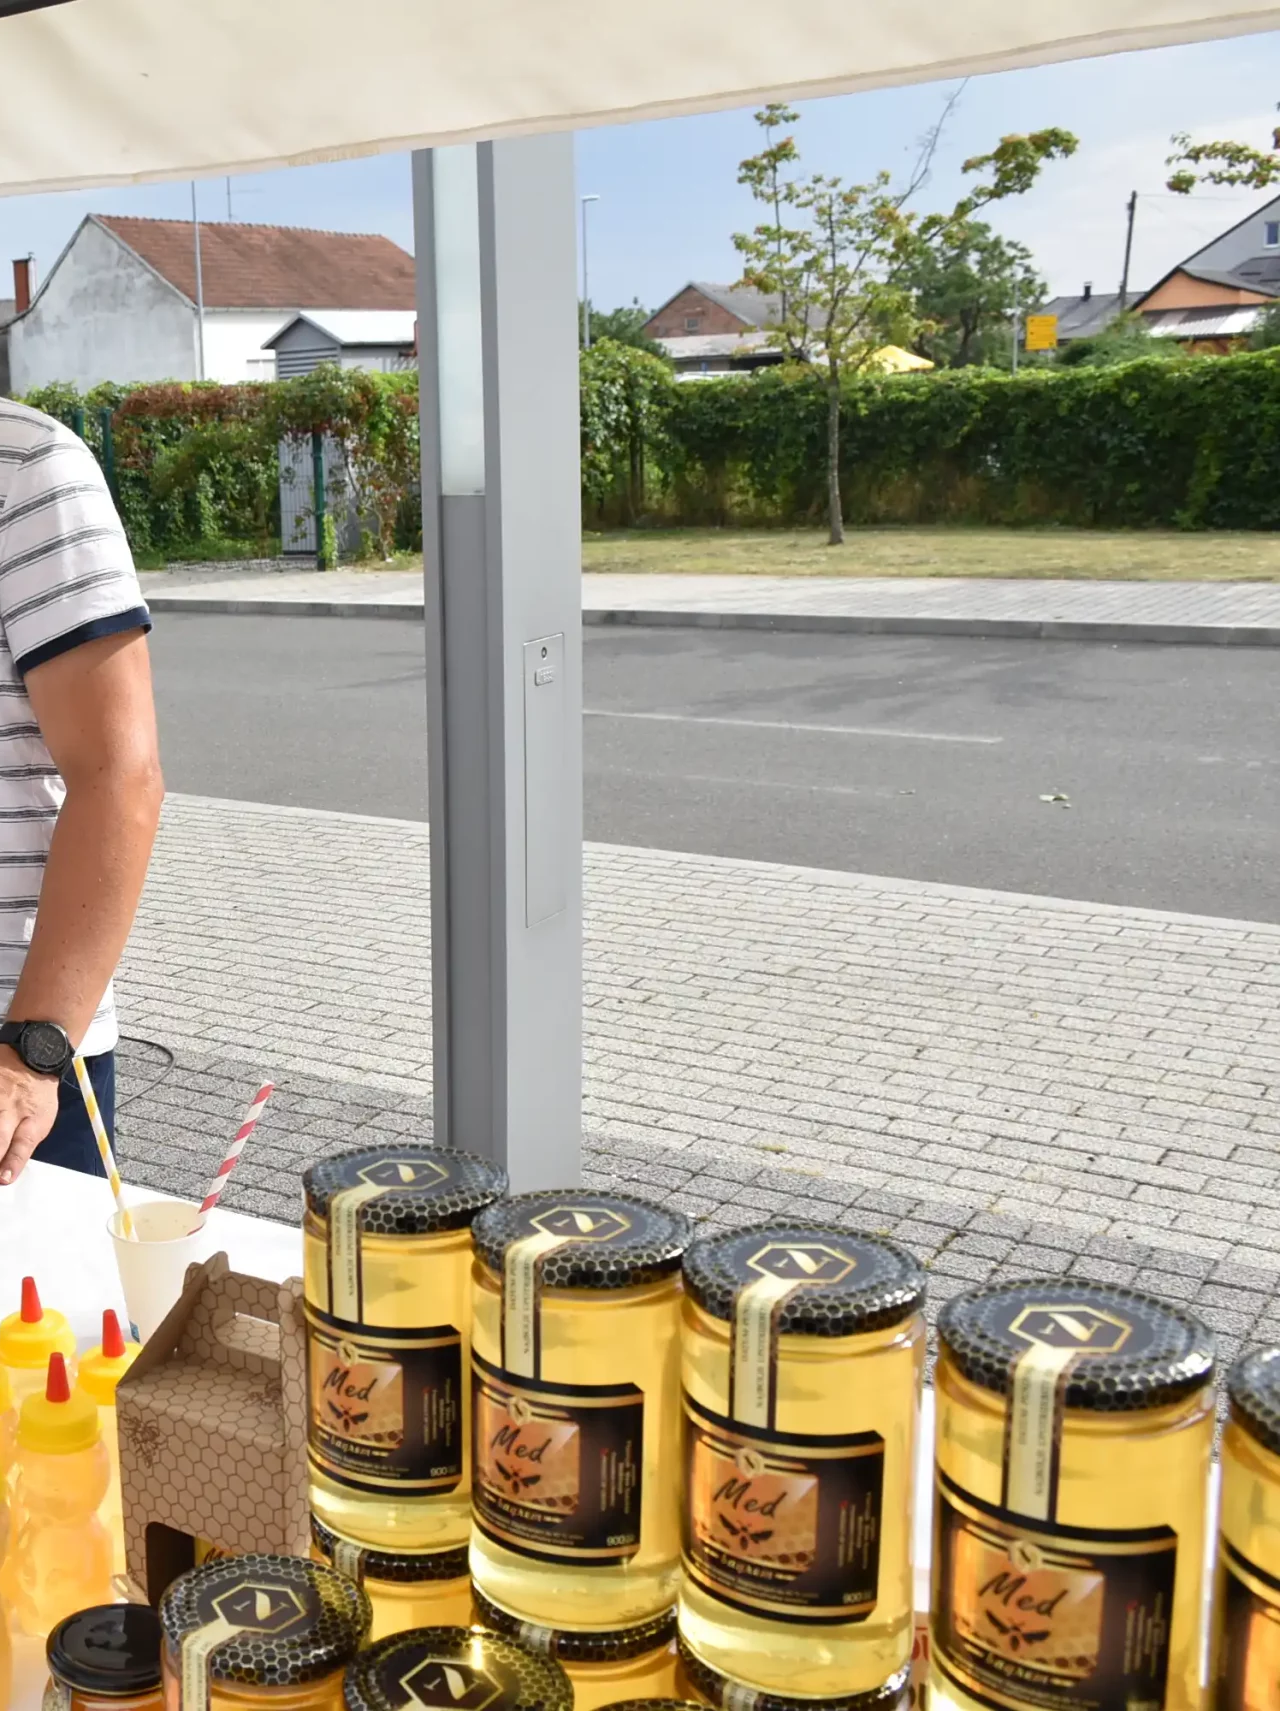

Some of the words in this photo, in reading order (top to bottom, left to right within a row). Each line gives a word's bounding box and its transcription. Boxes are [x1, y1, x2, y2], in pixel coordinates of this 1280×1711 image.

[322, 1367, 378, 1403] Med
[491, 1424, 553, 1464] Med
[430, 1466, 448, 1478] 900
[712, 1477, 788, 1519] Med
[606, 1534, 624, 1546] 900
[977, 1571, 1069, 1618] Med
